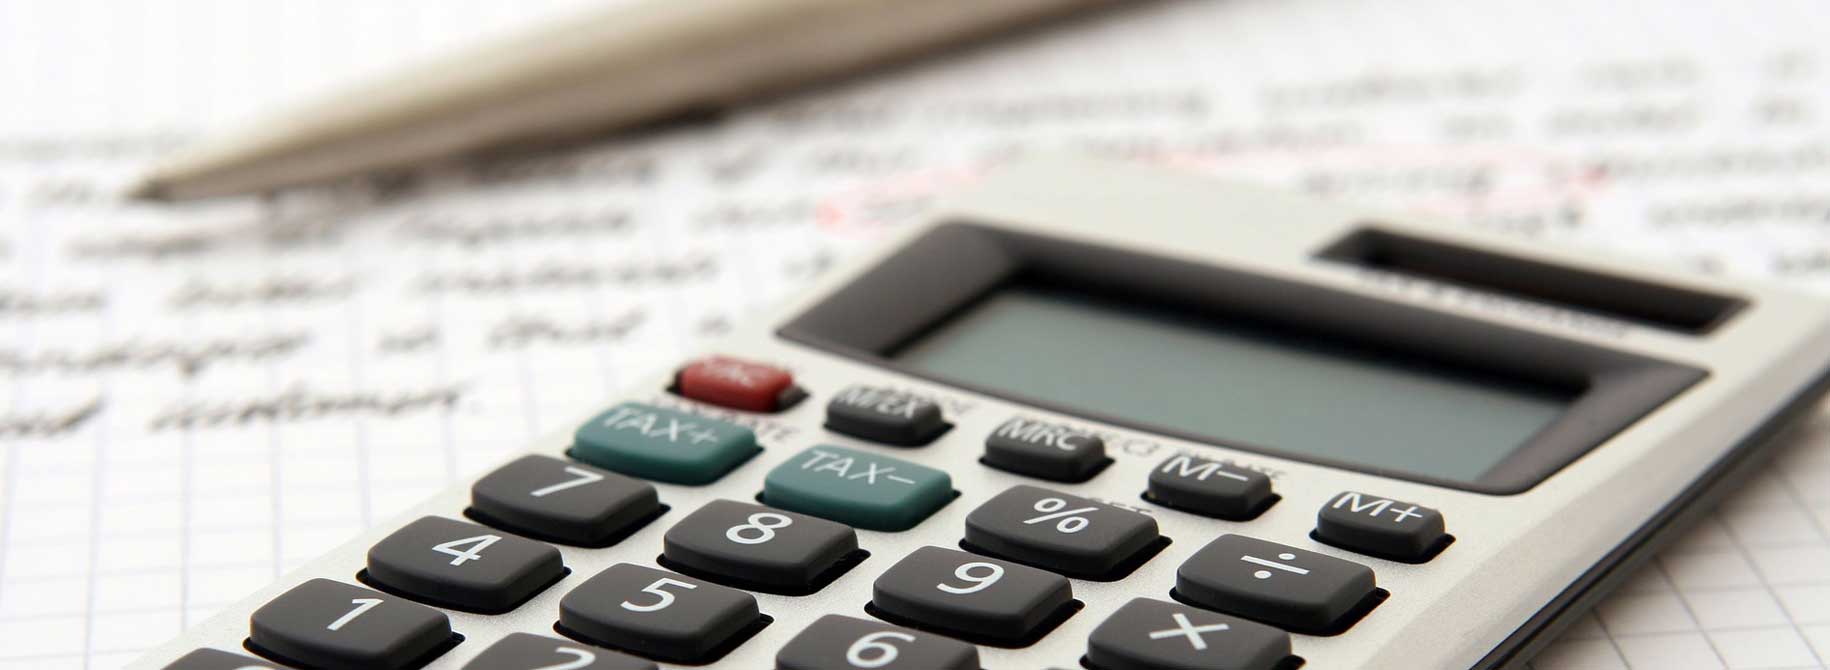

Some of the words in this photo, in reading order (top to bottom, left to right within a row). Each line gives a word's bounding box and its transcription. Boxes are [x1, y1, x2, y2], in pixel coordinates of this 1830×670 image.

[603, 407, 719, 444] TAX+
[998, 416, 1088, 451] MRC
[530, 465, 605, 497] 7
[801, 450, 916, 485] TAX-
[1161, 455, 1249, 481] M-
[1023, 497, 1100, 534] %
[1331, 491, 1423, 523] M+
[725, 512, 793, 545] 8
[431, 534, 503, 567] 4
[620, 577, 698, 612] 5
[936, 561, 1005, 595] 9
[326, 598, 385, 631] 1
[531, 646, 596, 670] 2
[846, 630, 916, 668] 6
